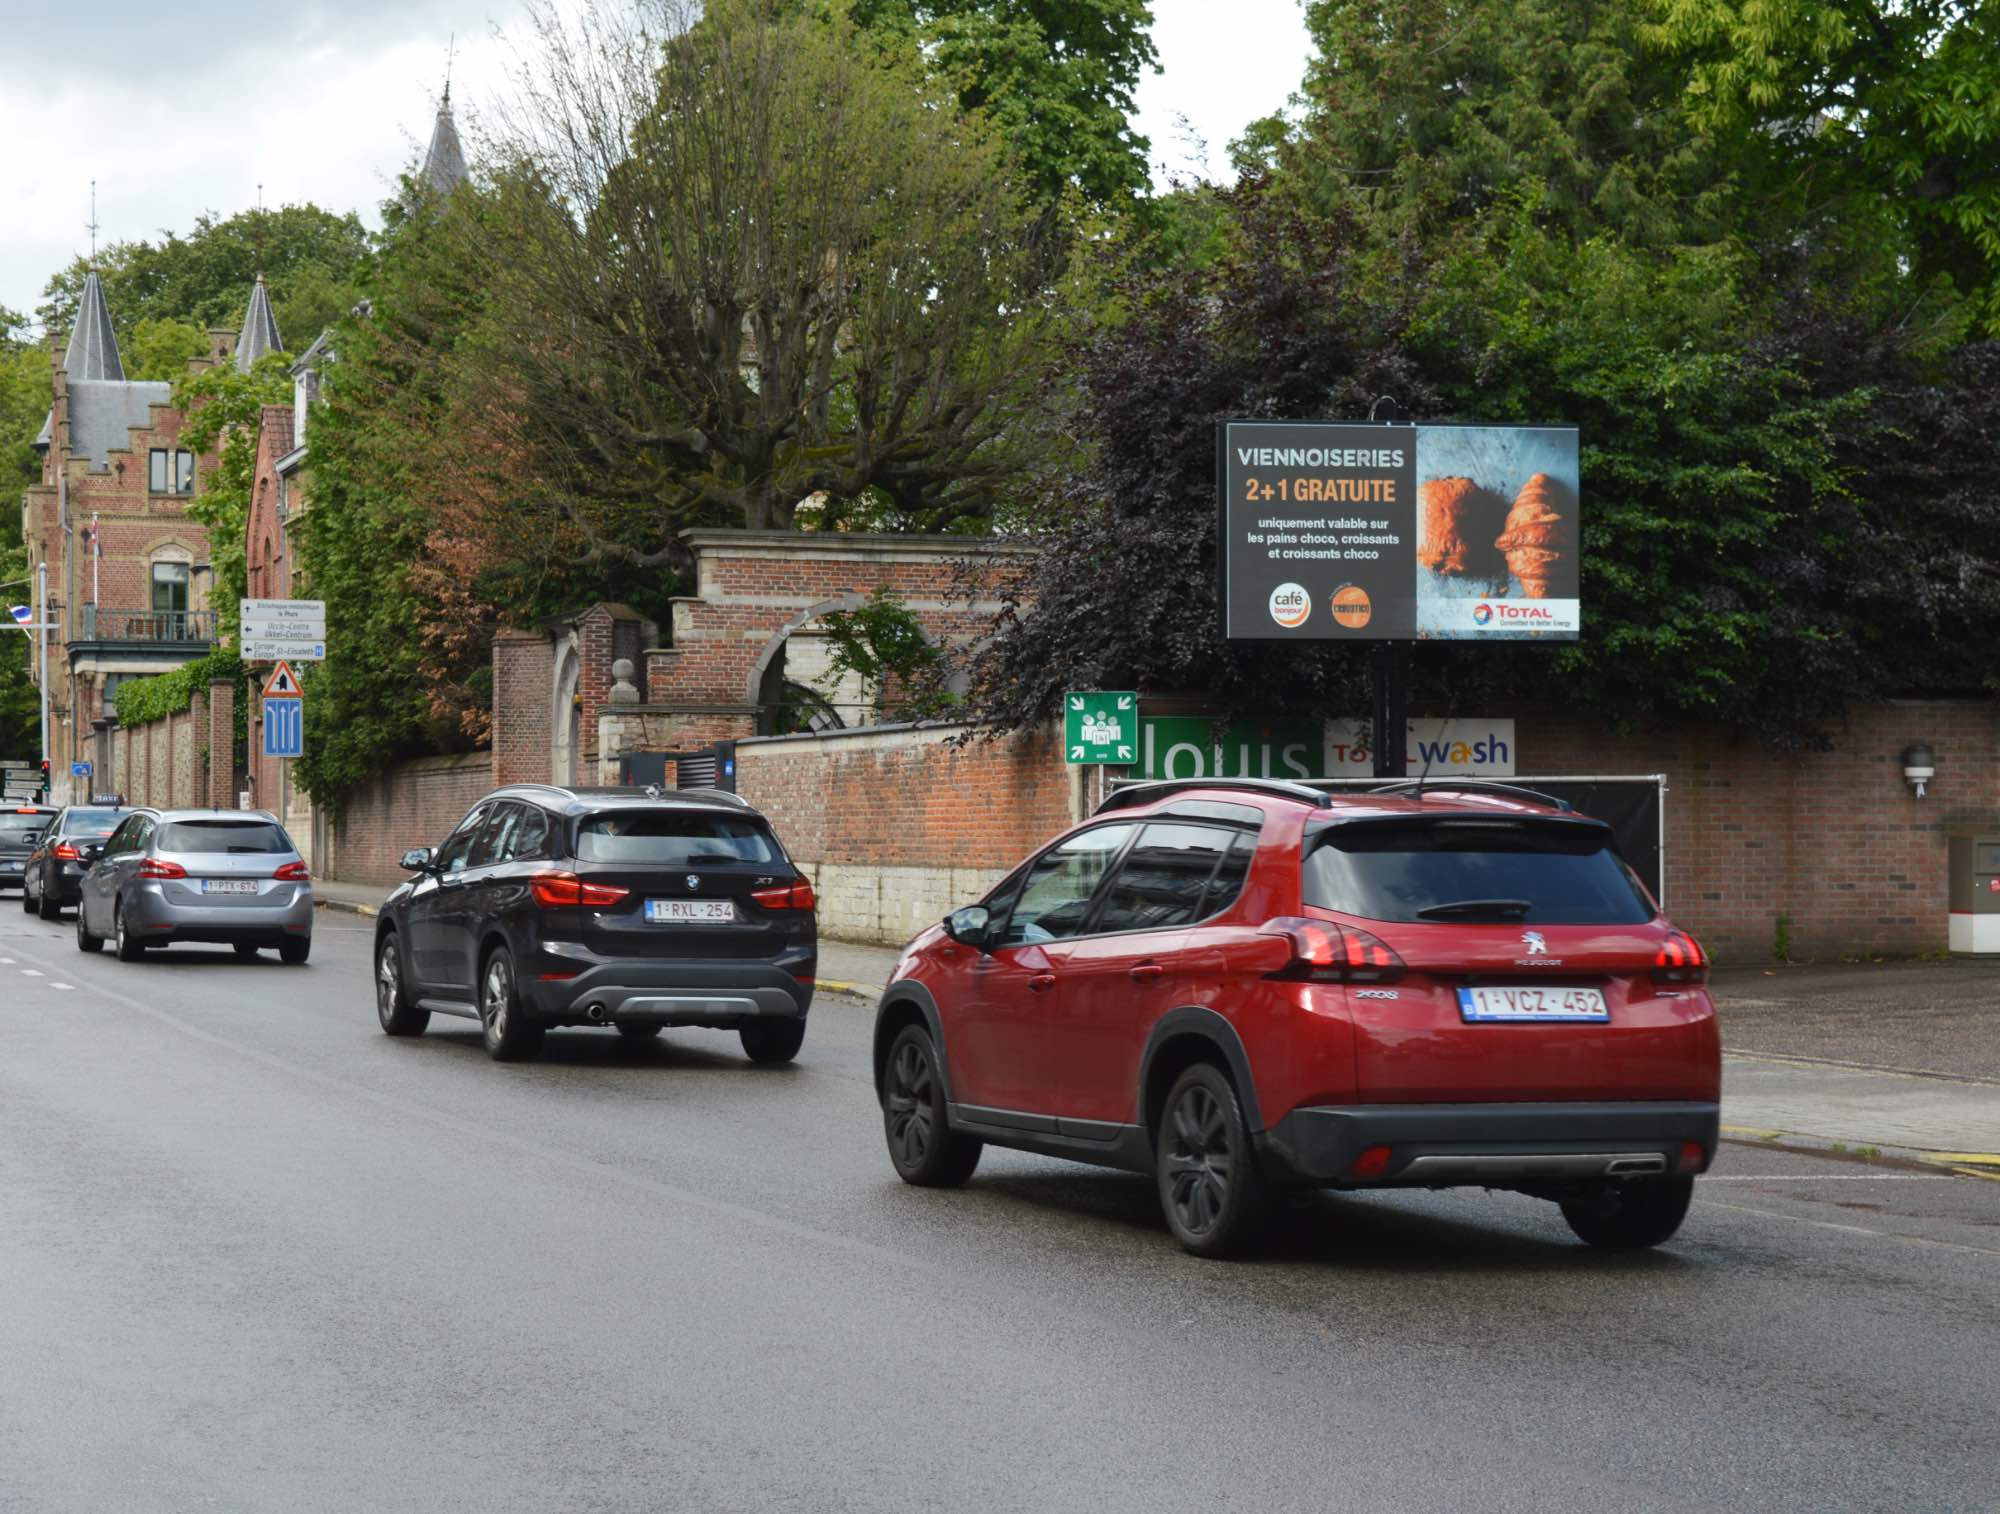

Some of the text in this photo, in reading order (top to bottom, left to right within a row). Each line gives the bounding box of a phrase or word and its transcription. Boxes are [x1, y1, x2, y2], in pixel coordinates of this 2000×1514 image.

[1237, 448, 1405, 468] VIENNOISERIES
[1246, 478, 1396, 502] 2+1 GRATUITE
[1258, 517, 1389, 530] uniquement valable sur
[1247, 532, 1400, 545] les pains choco, croissants
[1268, 549, 1379, 559] et croissants choco
[1275, 592, 1303, 605] café
[1496, 604, 1553, 618] TOTAL
[1417, 733, 1508, 764] wash
